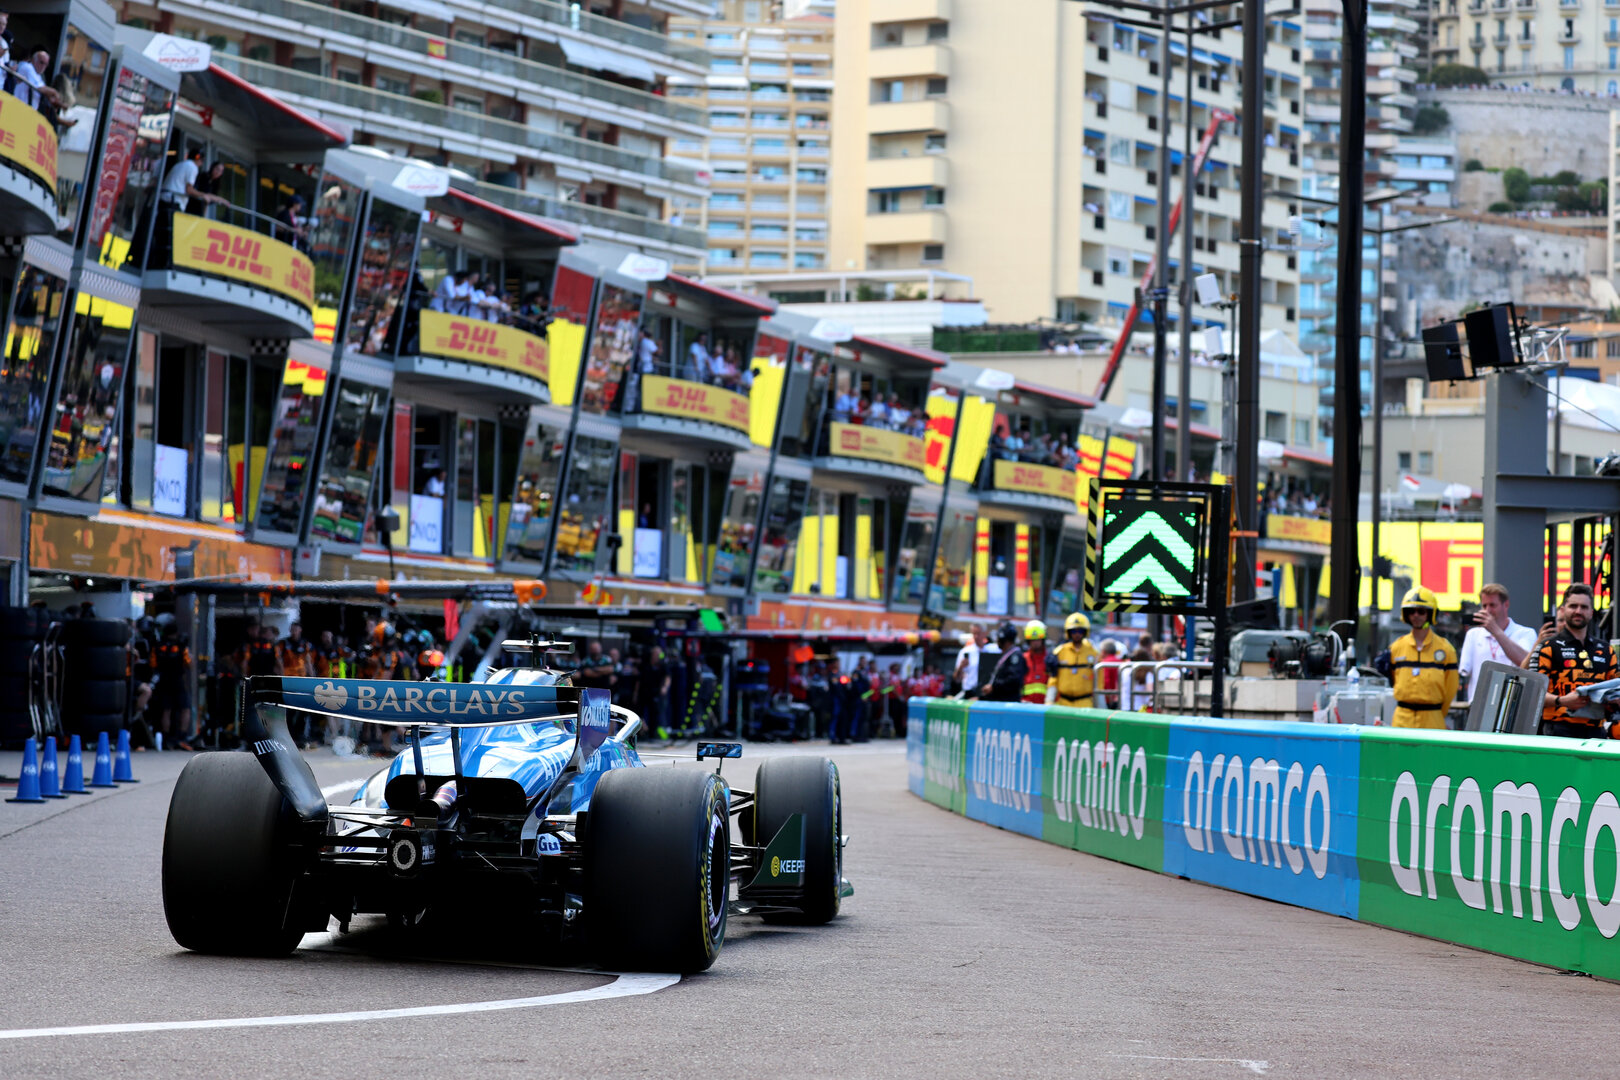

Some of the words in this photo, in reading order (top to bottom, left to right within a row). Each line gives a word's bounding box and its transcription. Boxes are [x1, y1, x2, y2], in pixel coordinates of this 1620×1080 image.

[204, 228, 265, 276] DHL
[446, 321, 500, 357] DHL
[666, 384, 710, 413] DHL
[357, 685, 526, 716] BARCLAYS
[972, 727, 1032, 814] aramco
[1052, 737, 1147, 841] aramco
[1183, 750, 1331, 880] aramco
[1389, 770, 1620, 939] aramco
